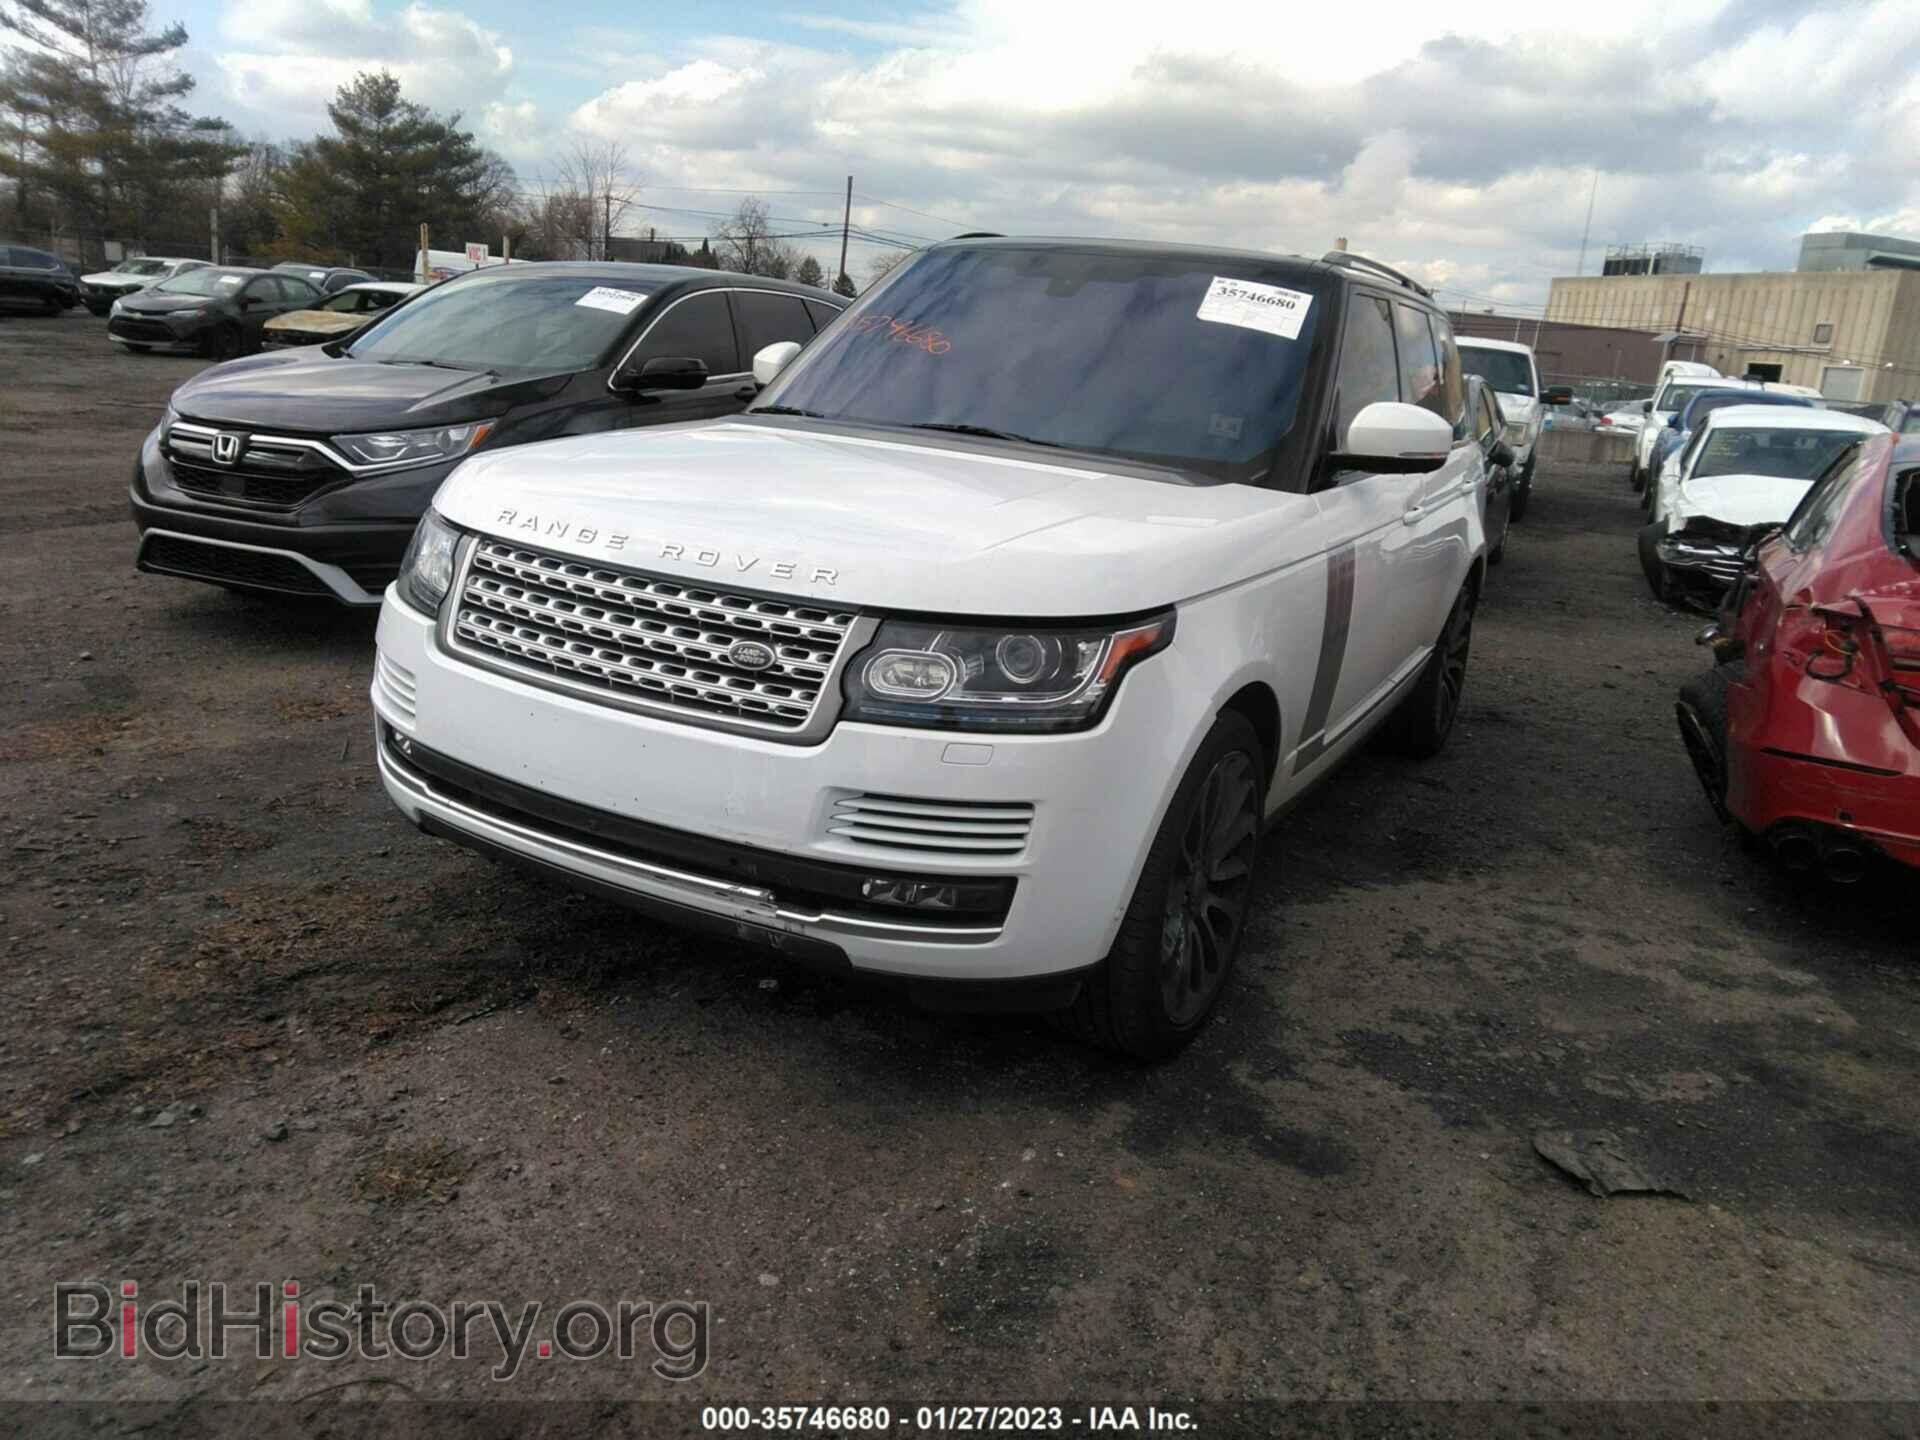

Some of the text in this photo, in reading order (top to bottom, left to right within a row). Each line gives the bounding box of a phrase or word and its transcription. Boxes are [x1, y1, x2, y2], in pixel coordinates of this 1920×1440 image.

[1217, 286, 1296, 310] 35746680
[496, 509, 841, 586] RANGE ROVER
